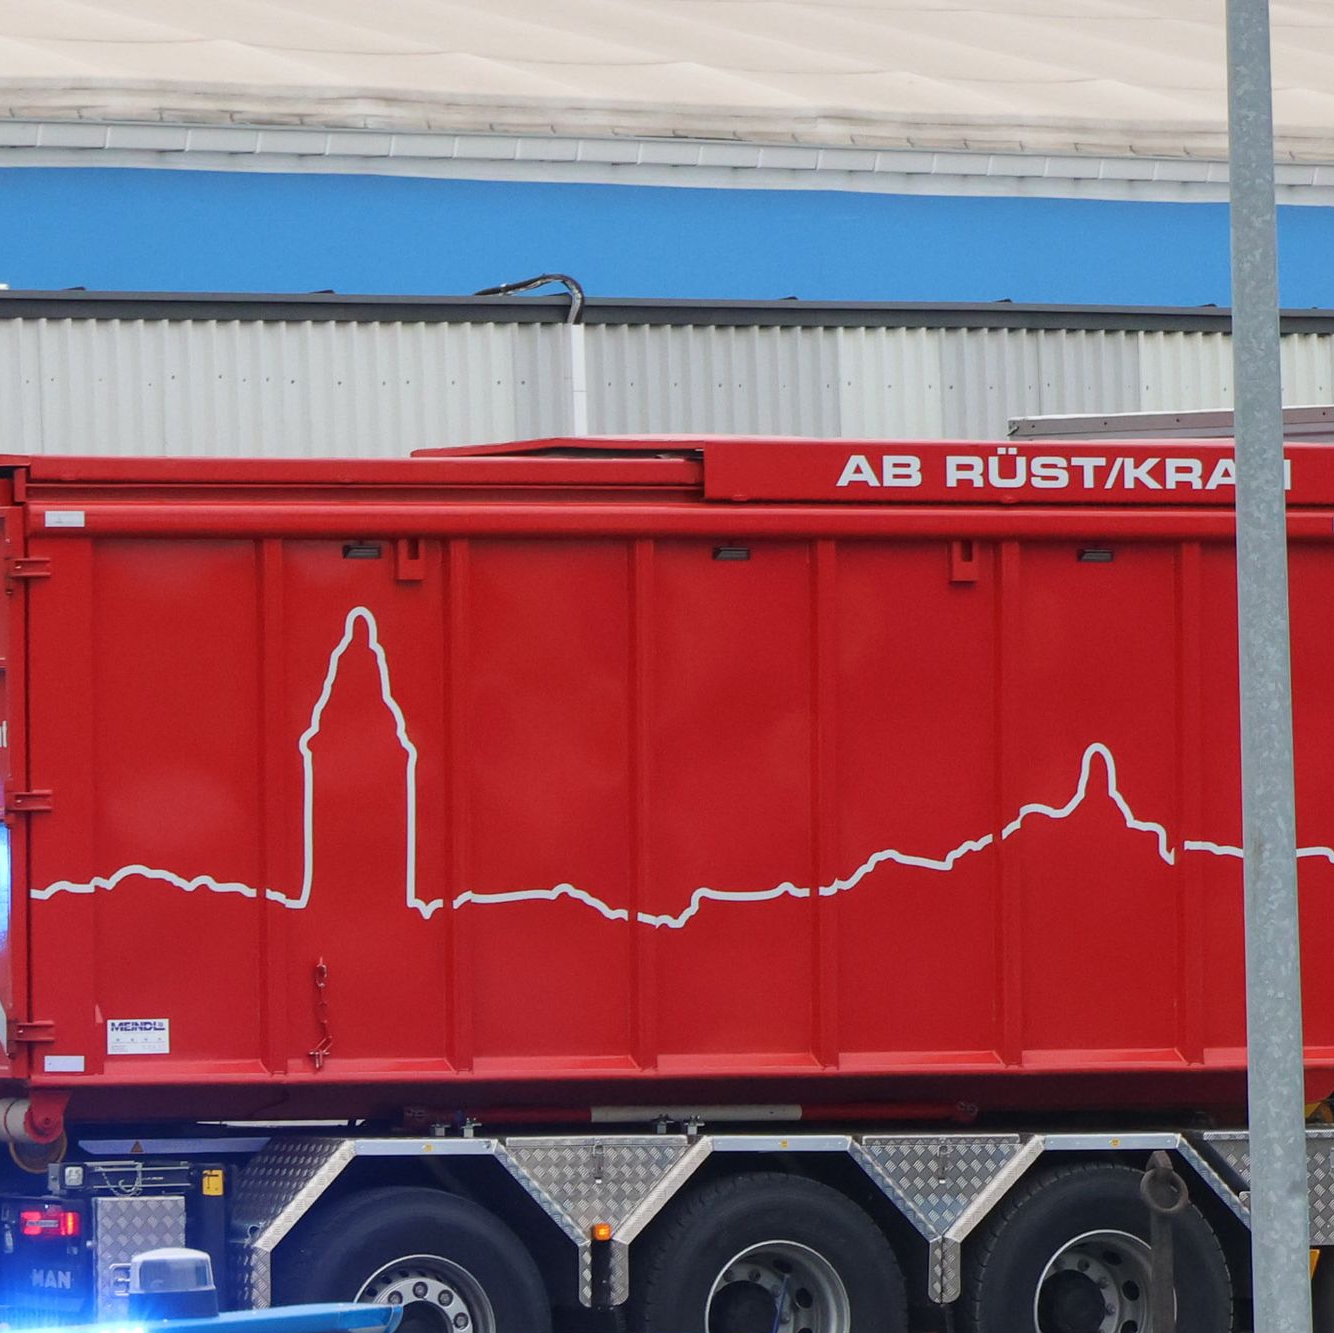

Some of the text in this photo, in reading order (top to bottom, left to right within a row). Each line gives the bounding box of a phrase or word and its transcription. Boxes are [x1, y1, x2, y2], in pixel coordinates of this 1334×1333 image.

[837, 447, 1291, 490] AB RÜST/KRA
[32, 1268, 71, 1289] MAN
